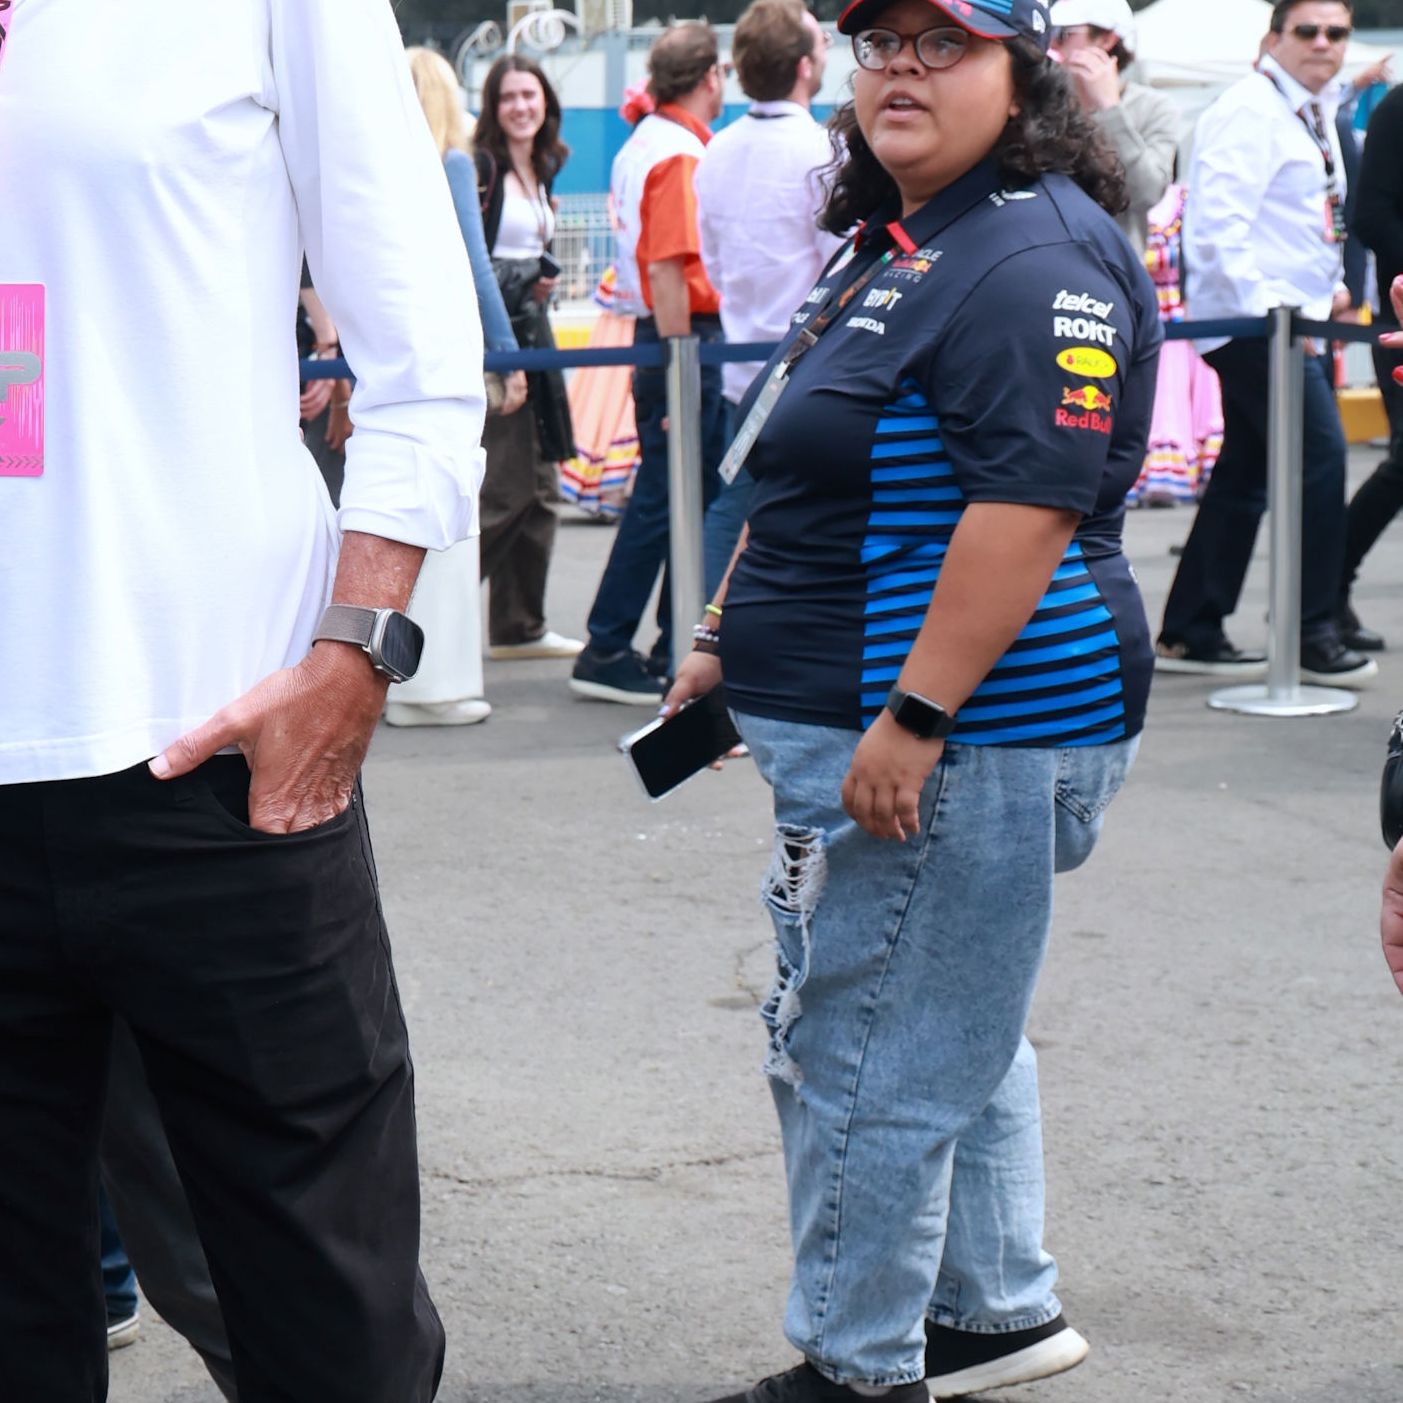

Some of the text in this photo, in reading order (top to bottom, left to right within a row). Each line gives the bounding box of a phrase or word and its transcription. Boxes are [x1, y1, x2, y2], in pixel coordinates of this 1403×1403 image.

[1052, 289, 1114, 319] telcel
[1053, 316, 1117, 346] ROKT
[1055, 408, 1112, 435] Red Bull
